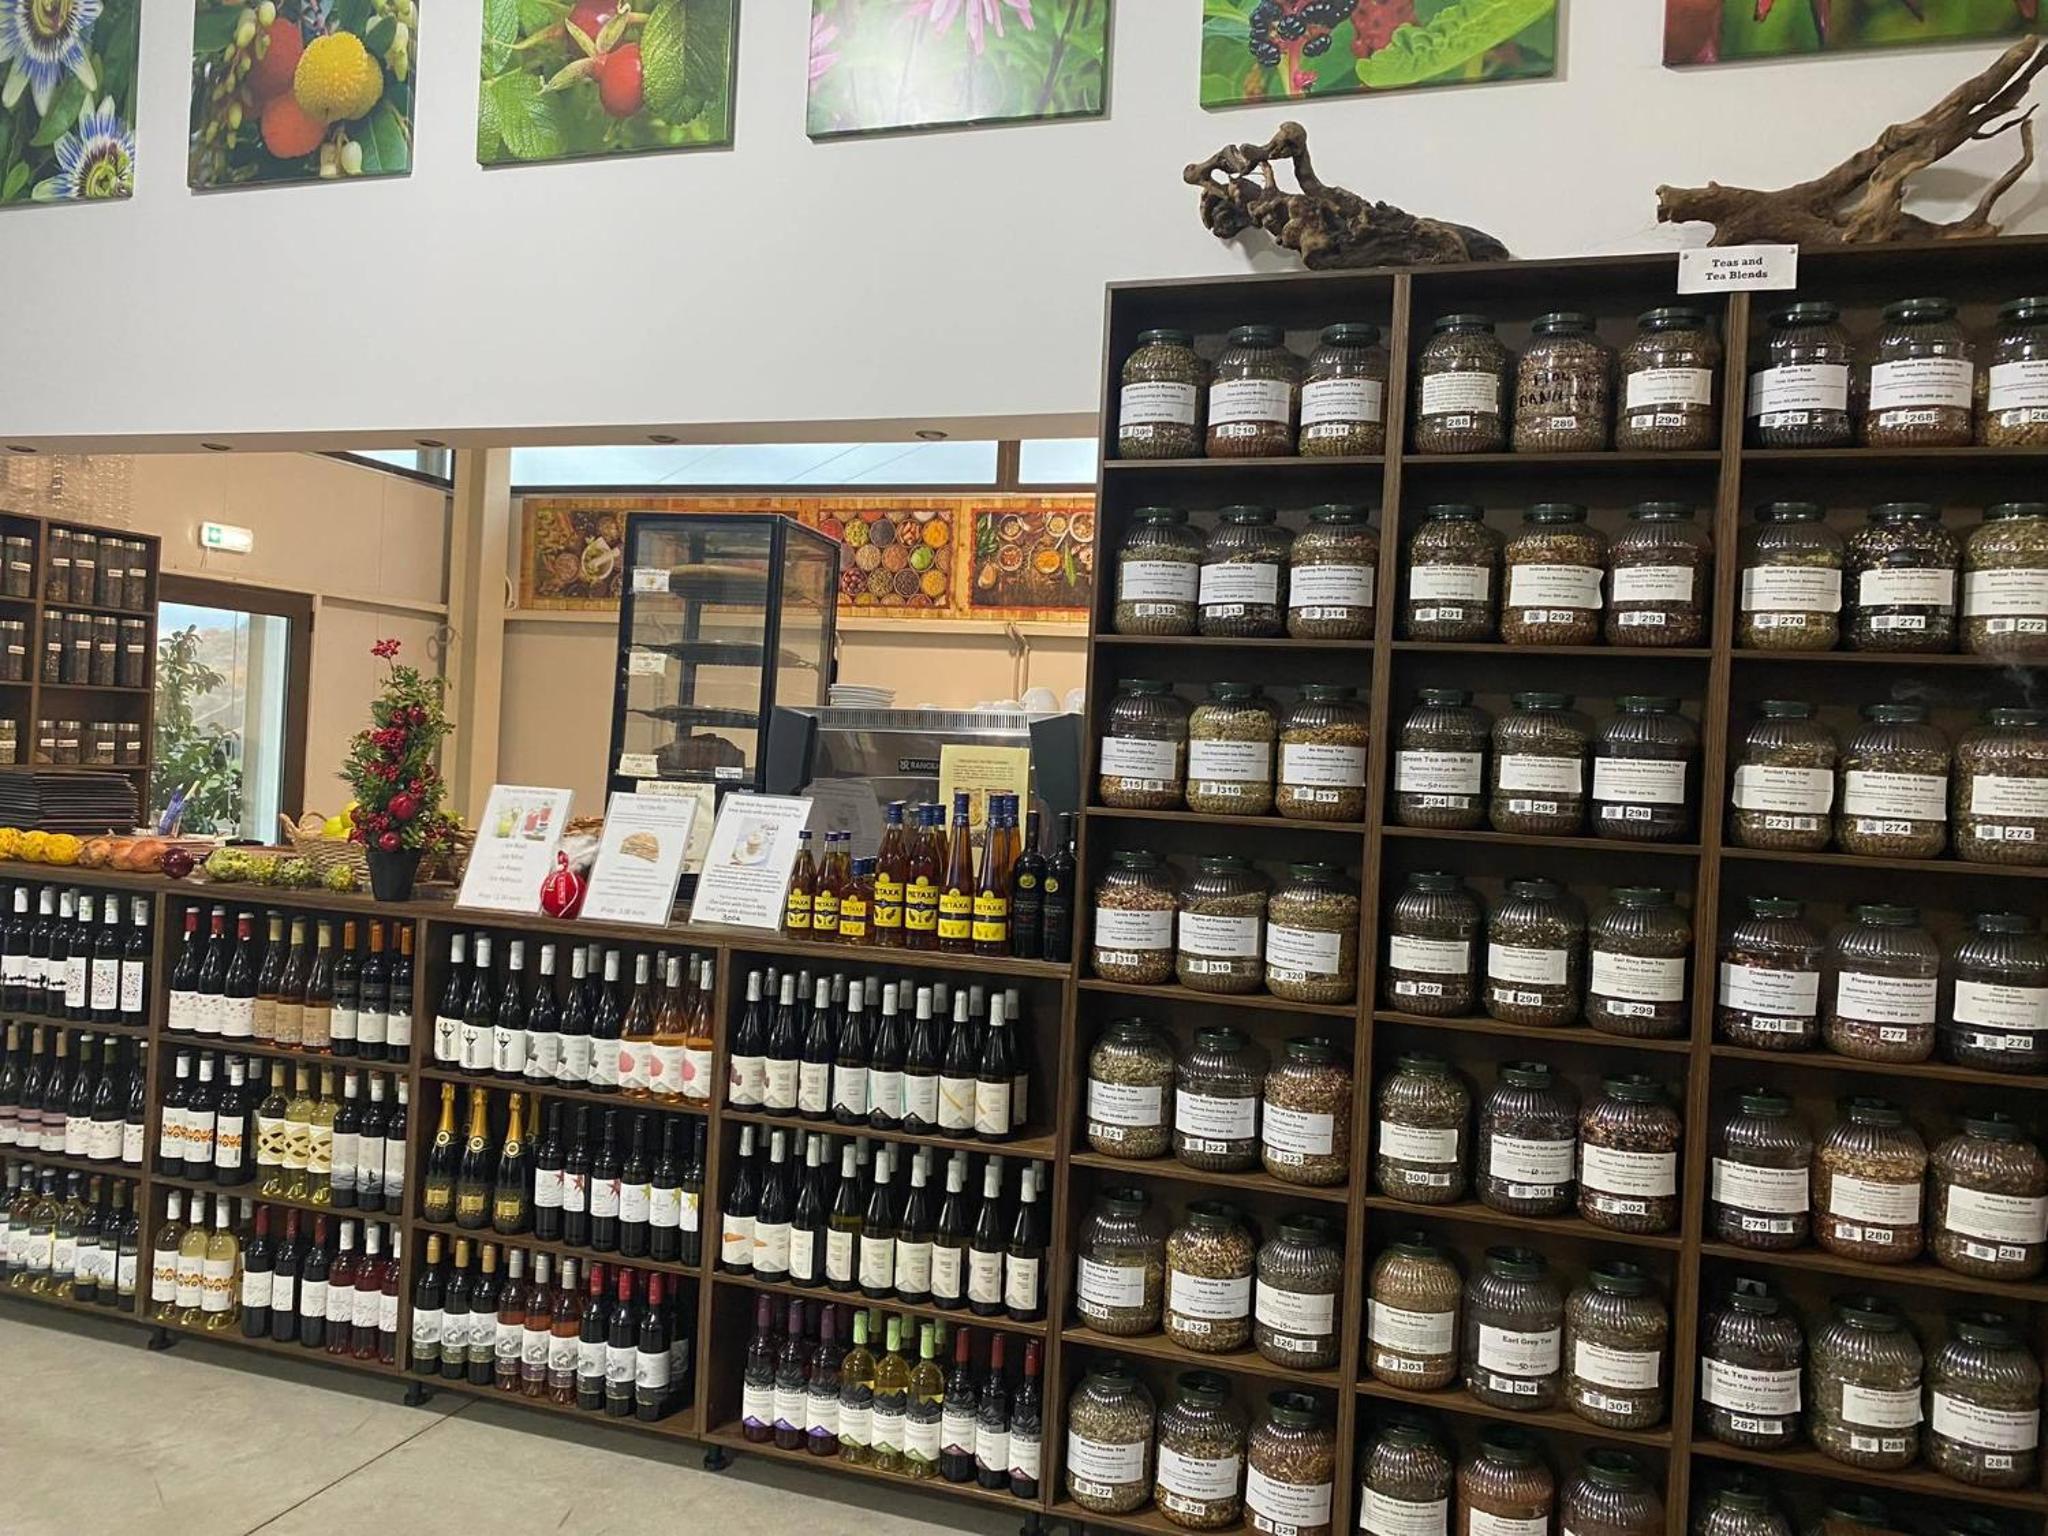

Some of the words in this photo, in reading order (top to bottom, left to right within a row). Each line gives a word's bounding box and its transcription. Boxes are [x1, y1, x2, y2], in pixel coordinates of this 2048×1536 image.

[1712, 258, 1738, 267] Teas
[1742, 257, 1763, 266] and
[1705, 272, 1726, 280] Tea
[1729, 270, 1768, 280] Blends
[1782, 415, 1806, 423] 267
[1909, 414, 1932, 422] 268
[2032, 412, 2048, 420] 26
[1554, 418, 1573, 427] 289
[1440, 610, 1460, 618] 291
[1551, 613, 1571, 621] 292
[1642, 614, 1663, 623] 293
[1781, 617, 1803, 626] 270
[1900, 618, 1922, 626] 271
[2019, 621, 2043, 630] 272
[1124, 781, 1139, 789] 315
[1221, 786, 1239, 795] 316
[1318, 793, 1336, 801] 317
[1425, 797, 1445, 806] 294
[1535, 804, 1555, 812] 295
[1628, 809, 1649, 818] 298
[1768, 819, 1790, 828] 273
[1885, 823, 1908, 833] 274
[2008, 829, 2032, 839] 275
[1749, 970, 1781, 979] Cranberry
[1420, 985, 1440, 994] 297
[1520, 995, 1539, 1004] 296
[1632, 1005, 1653, 1015] 299
[1754, 1020, 1776, 1029] 276
[1882, 1031, 1904, 1040] 277
[2008, 1038, 2031, 1048] 278
[1105, 1129, 1121, 1138] 321
[1207, 1144, 1225, 1152] 322
[1284, 1154, 1302, 1162] 323
[1407, 1173, 1427, 1182] 300
[1534, 1188, 1552, 1196] 301
[1622, 1203, 1642, 1213] 302
[1745, 1219, 1766, 1229] 279
[1868, 1231, 1890, 1241] 280
[2001, 1249, 2023, 1259] 281
[1090, 1308, 1106, 1317] 324
[1191, 1323, 1209, 1331] 325
[1277, 1338, 1293, 1346] 326
[1521, 1338, 1538, 1346] Grey
[1402, 1362, 1422, 1372] 303
[1732, 1371, 1748, 1379] Tea
[1751, 1374, 1770, 1382] with
[1516, 1384, 1535, 1392] 304
[1609, 1402, 1630, 1412] 305
[1733, 1419, 1756, 1430] 282
[1884, 1440, 1904, 1450] 283
[1987, 1457, 2010, 1468] 284
[1093, 1488, 1110, 1497] 327
[1185, 1504, 1203, 1513] 328
[1276, 1526, 1296, 1535] 329
